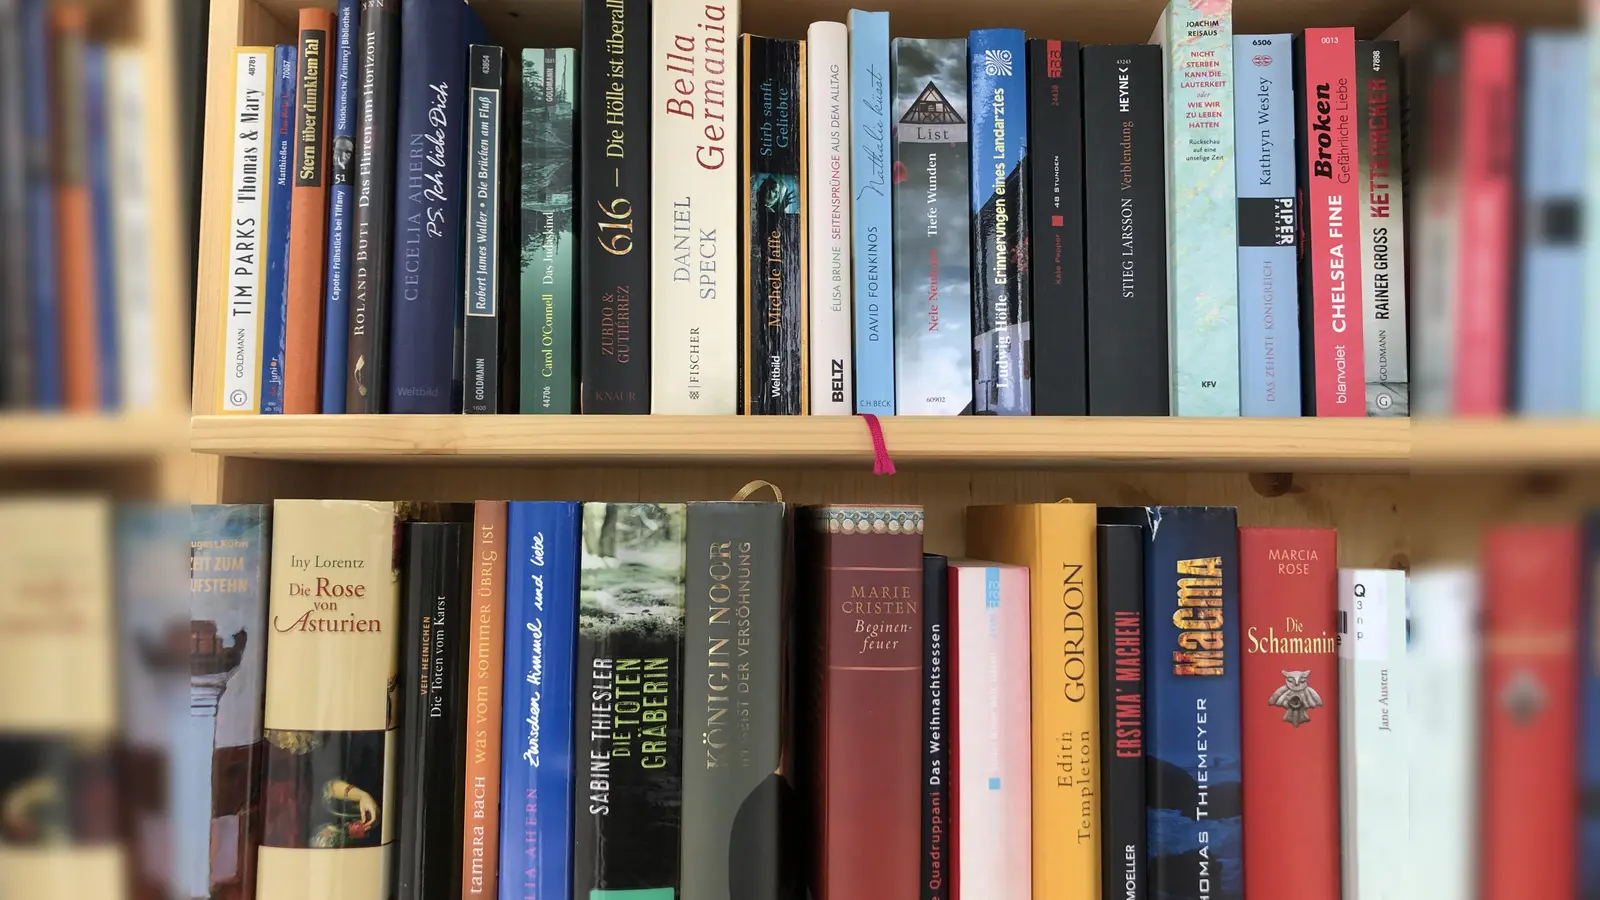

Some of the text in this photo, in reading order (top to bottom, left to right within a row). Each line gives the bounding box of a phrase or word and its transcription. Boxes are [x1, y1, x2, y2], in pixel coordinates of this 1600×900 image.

[341, 7, 350, 45] Bibliothek
[241, 89, 263, 123] Mary
[429, 82, 448, 128] Dich
[666, 35, 695, 119] Bella
[695, 4, 725, 170] Germania
[300, 39, 319, 179] Stern über dunklem Tal
[597, 0, 633, 255] 616 Die Hölle ist überall
[776, 88, 789, 148] Geliebte
[916, 132, 949, 141] List
[1313, 83, 1332, 179] Broken
[1336, 78, 1351, 184] Gefährliche Liebe
[238, 147, 258, 202] Thomas
[278, 141, 287, 185] Matthießen
[354, 31, 376, 335] ROLAND Das Flirren am Horizont
[1119, 75, 1134, 298] STIEG LARSSON Verblendung HEYNE
[235, 218, 255, 275] PARKS
[332, 191, 345, 300] Capote: Frühstück bei Tiffany
[404, 133, 424, 301] CECELIA AHERN
[542, 212, 555, 264] Judaskind
[674, 197, 690, 281] DANIEL
[830, 64, 844, 402] BELTZ BRUNE SEITENSPRÜNGE AUS DEM ALLTAG
[926, 153, 938, 331] Nele Tiefe Wunden
[992, 88, 1012, 389] Ludwig Höfle Erinnerungen eines Landarztes
[1257, 77, 1275, 402] DAS Kathryn Wesley
[1280, 199, 1294, 244] PIPER
[476, 97, 492, 400] GOLDMANN Robert James Waller Die Brücken am Fluß
[543, 266, 553, 285] Das
[700, 228, 717, 300] SPECK
[1373, 228, 1388, 270] GROSS
[233, 286, 252, 316] TIM
[766, 230, 784, 398] Weltbild Michele Jaffe
[868, 226, 879, 342] DAVID FOENKINOS
[1328, 196, 1347, 404] blanvalet CHELSEA FINE
[1374, 274, 1389, 319] RAINER
[541, 294, 553, 346] O'Connell
[602, 307, 614, 355] ZURDO
[615, 286, 630, 363] GUTIÉRREZ
[236, 329, 245, 378] GOLDMANN
[541, 350, 552, 377] Carol
[690, 327, 700, 383] FISCHER
[1378, 330, 1388, 381] GOLDMANN
[596, 391, 636, 401] KNAUR
[291, 555, 364, 571] Iny Lorentz
[1269, 550, 1318, 560] MARCIA
[1278, 564, 1308, 574] ROSE
[289, 577, 365, 597] Die Rose
[313, 601, 337, 611] von
[842, 602, 916, 614] CRISTEN
[851, 586, 910, 599] MARIE
[274, 609, 381, 632] Asturien
[422, 616, 431, 670] HEINICHEN
[736, 542, 751, 693] DER VERSÖHNUNG
[855, 620, 912, 637] Beginen-
[860, 636, 899, 654] feuer
[1063, 563, 1085, 703] GORDON
[1248, 626, 1335, 654] Schamanin
[1286, 617, 1303, 632] Die
[431, 596, 445, 717] Die Toten vom Karst
[702, 541, 731, 769] KÖNIGIN NOOR
[1115, 611, 1141, 757] ERSTMA' MACHEN!
[523, 575, 543, 858] AHERN Zwischen Himmel und
[612, 659, 641, 756] DIE TOTEN
[637, 658, 668, 768] GRÄBERIN
[930, 624, 940, 753] Weihnachtsessen
[1378, 670, 1391, 731] Jane Austen
[475, 686, 488, 764] was vom
[589, 659, 612, 815] SABINE THIESLER
[930, 760, 940, 785] Das
[1056, 732, 1073, 787] Edith
[1078, 730, 1093, 844] Templeton
[1196, 699, 1208, 820] THIEMEYER
[930, 792, 942, 890] Quadruppani
